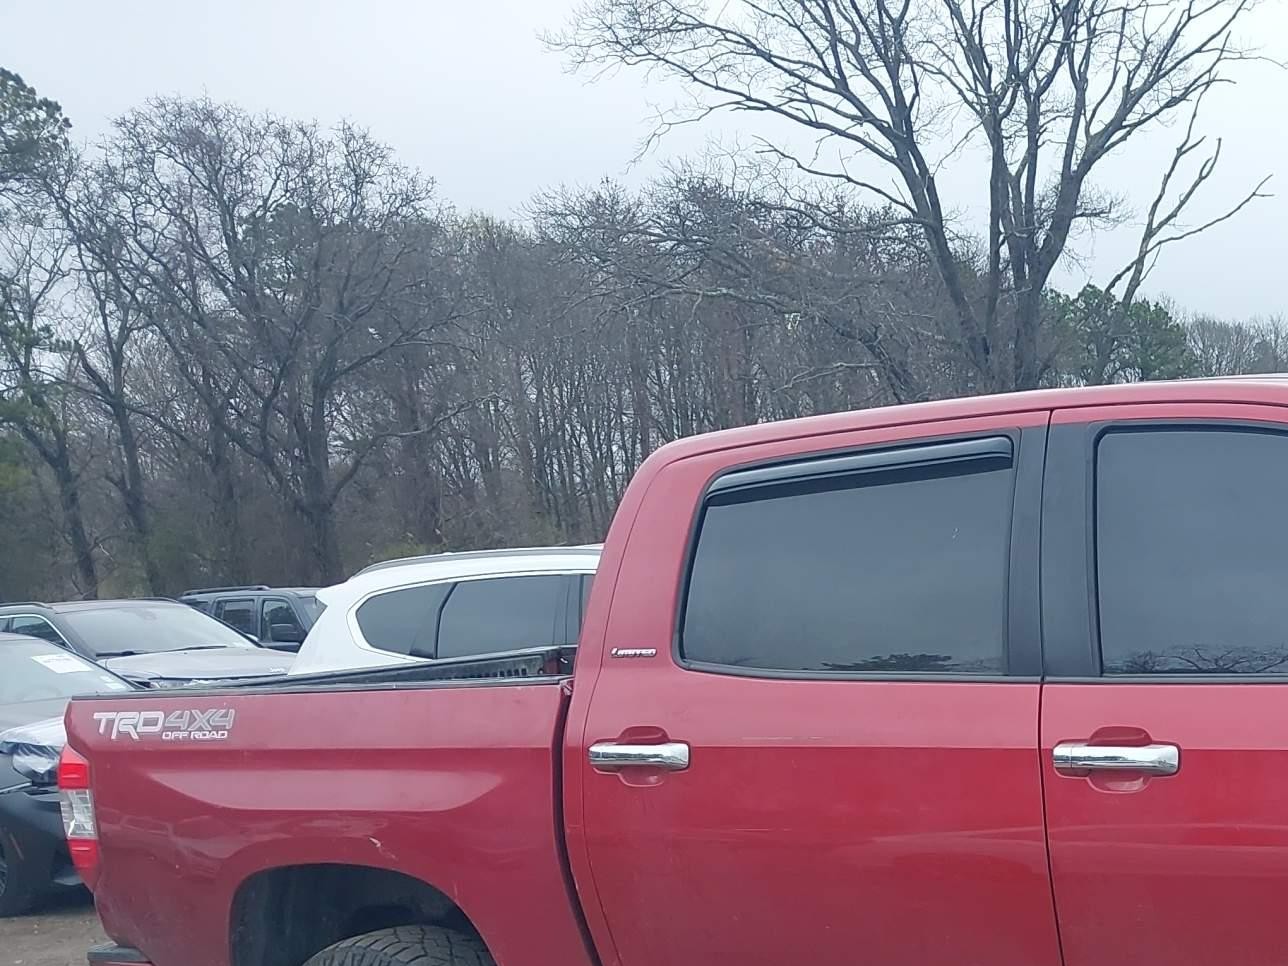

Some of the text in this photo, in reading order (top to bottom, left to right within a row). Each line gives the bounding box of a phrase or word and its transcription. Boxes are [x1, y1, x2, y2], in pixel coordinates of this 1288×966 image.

[93, 711, 165, 740] TRD
[162, 730, 229, 741] OFF ROAD
